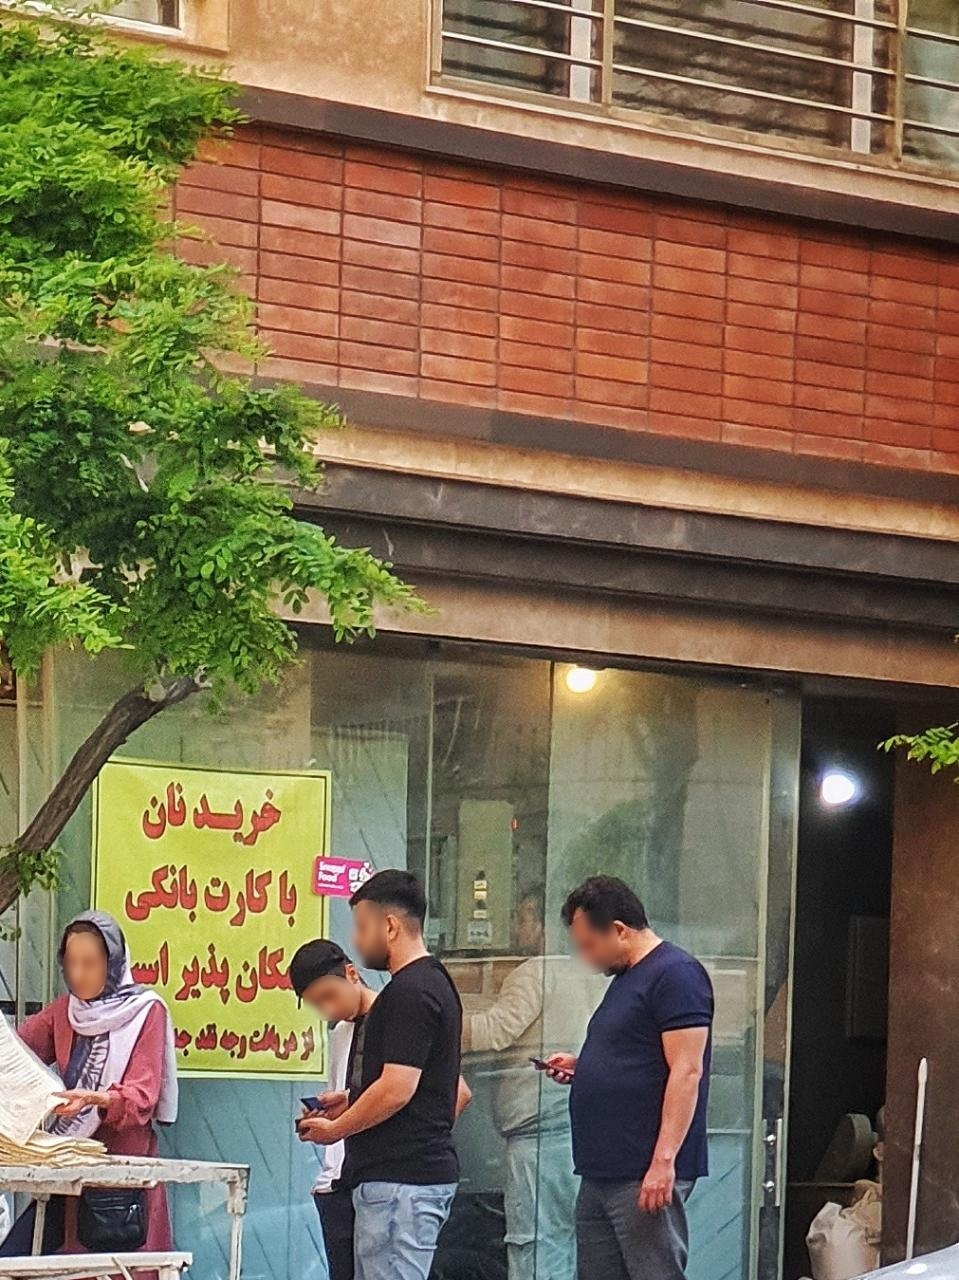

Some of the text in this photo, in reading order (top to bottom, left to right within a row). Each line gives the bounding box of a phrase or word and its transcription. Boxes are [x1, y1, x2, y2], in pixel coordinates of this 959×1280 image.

[142, 782, 187, 839] نان
[125, 864, 297, 927] با کارت بانکی
[175, 943, 230, 1005] پذیر
